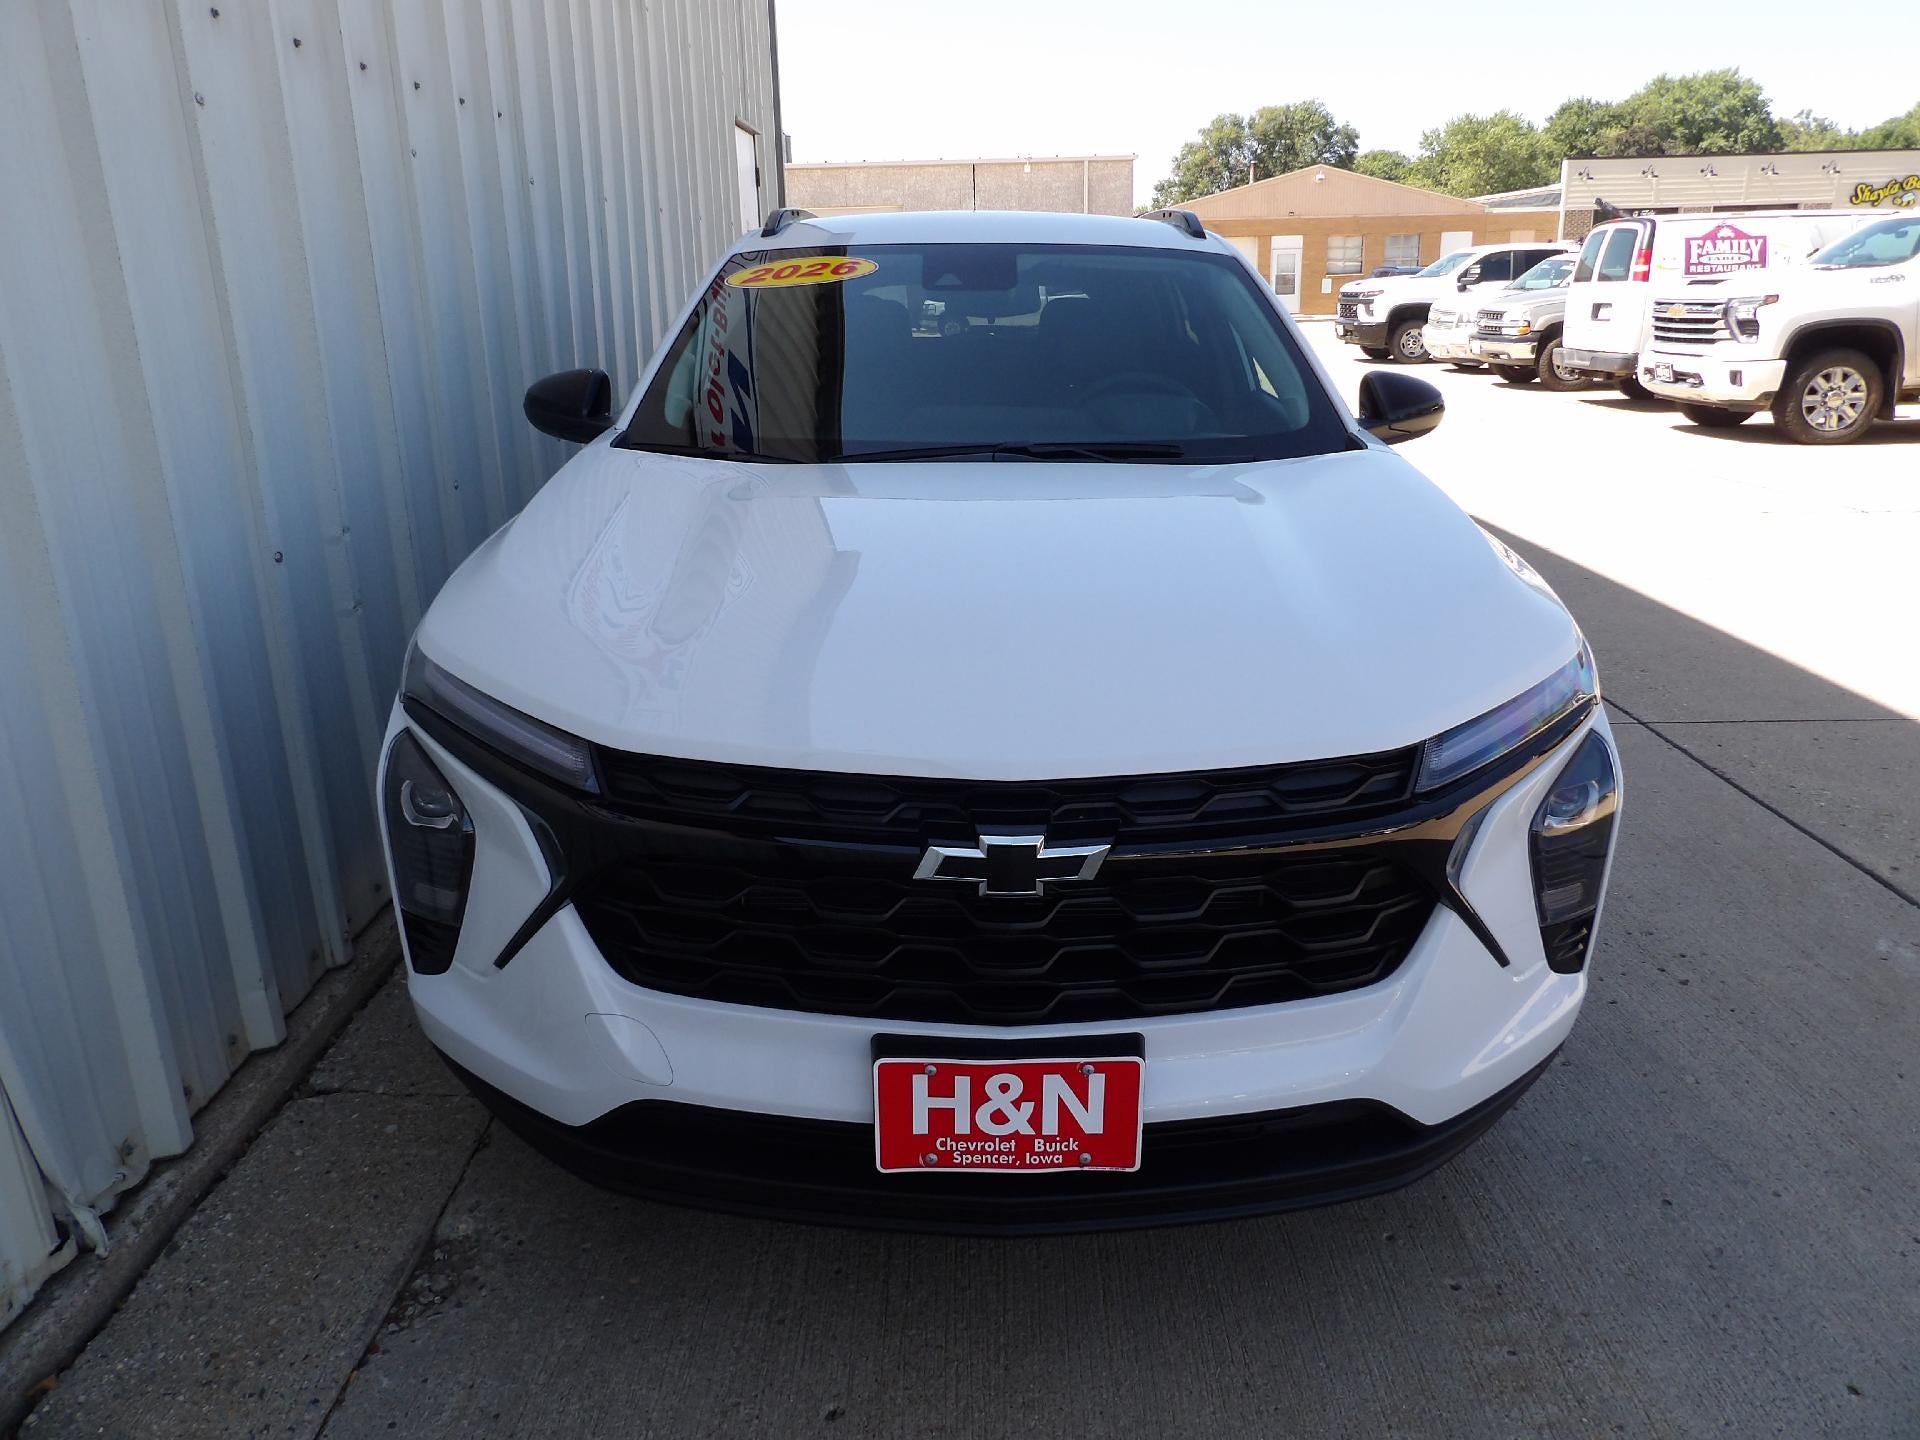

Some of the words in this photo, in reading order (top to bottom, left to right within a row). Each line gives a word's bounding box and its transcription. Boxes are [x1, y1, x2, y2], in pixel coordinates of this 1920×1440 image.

[1689, 239, 1763, 263] FAMILY
[743, 262, 862, 282] 2026
[912, 1073, 1106, 1135] H&N
[936, 1138, 1016, 1152] Chevrolet
[1034, 1138, 1079, 1152] Buick
[952, 1152, 1022, 1165] Spencer,
[1025, 1152, 1063, 1164] Iowa
